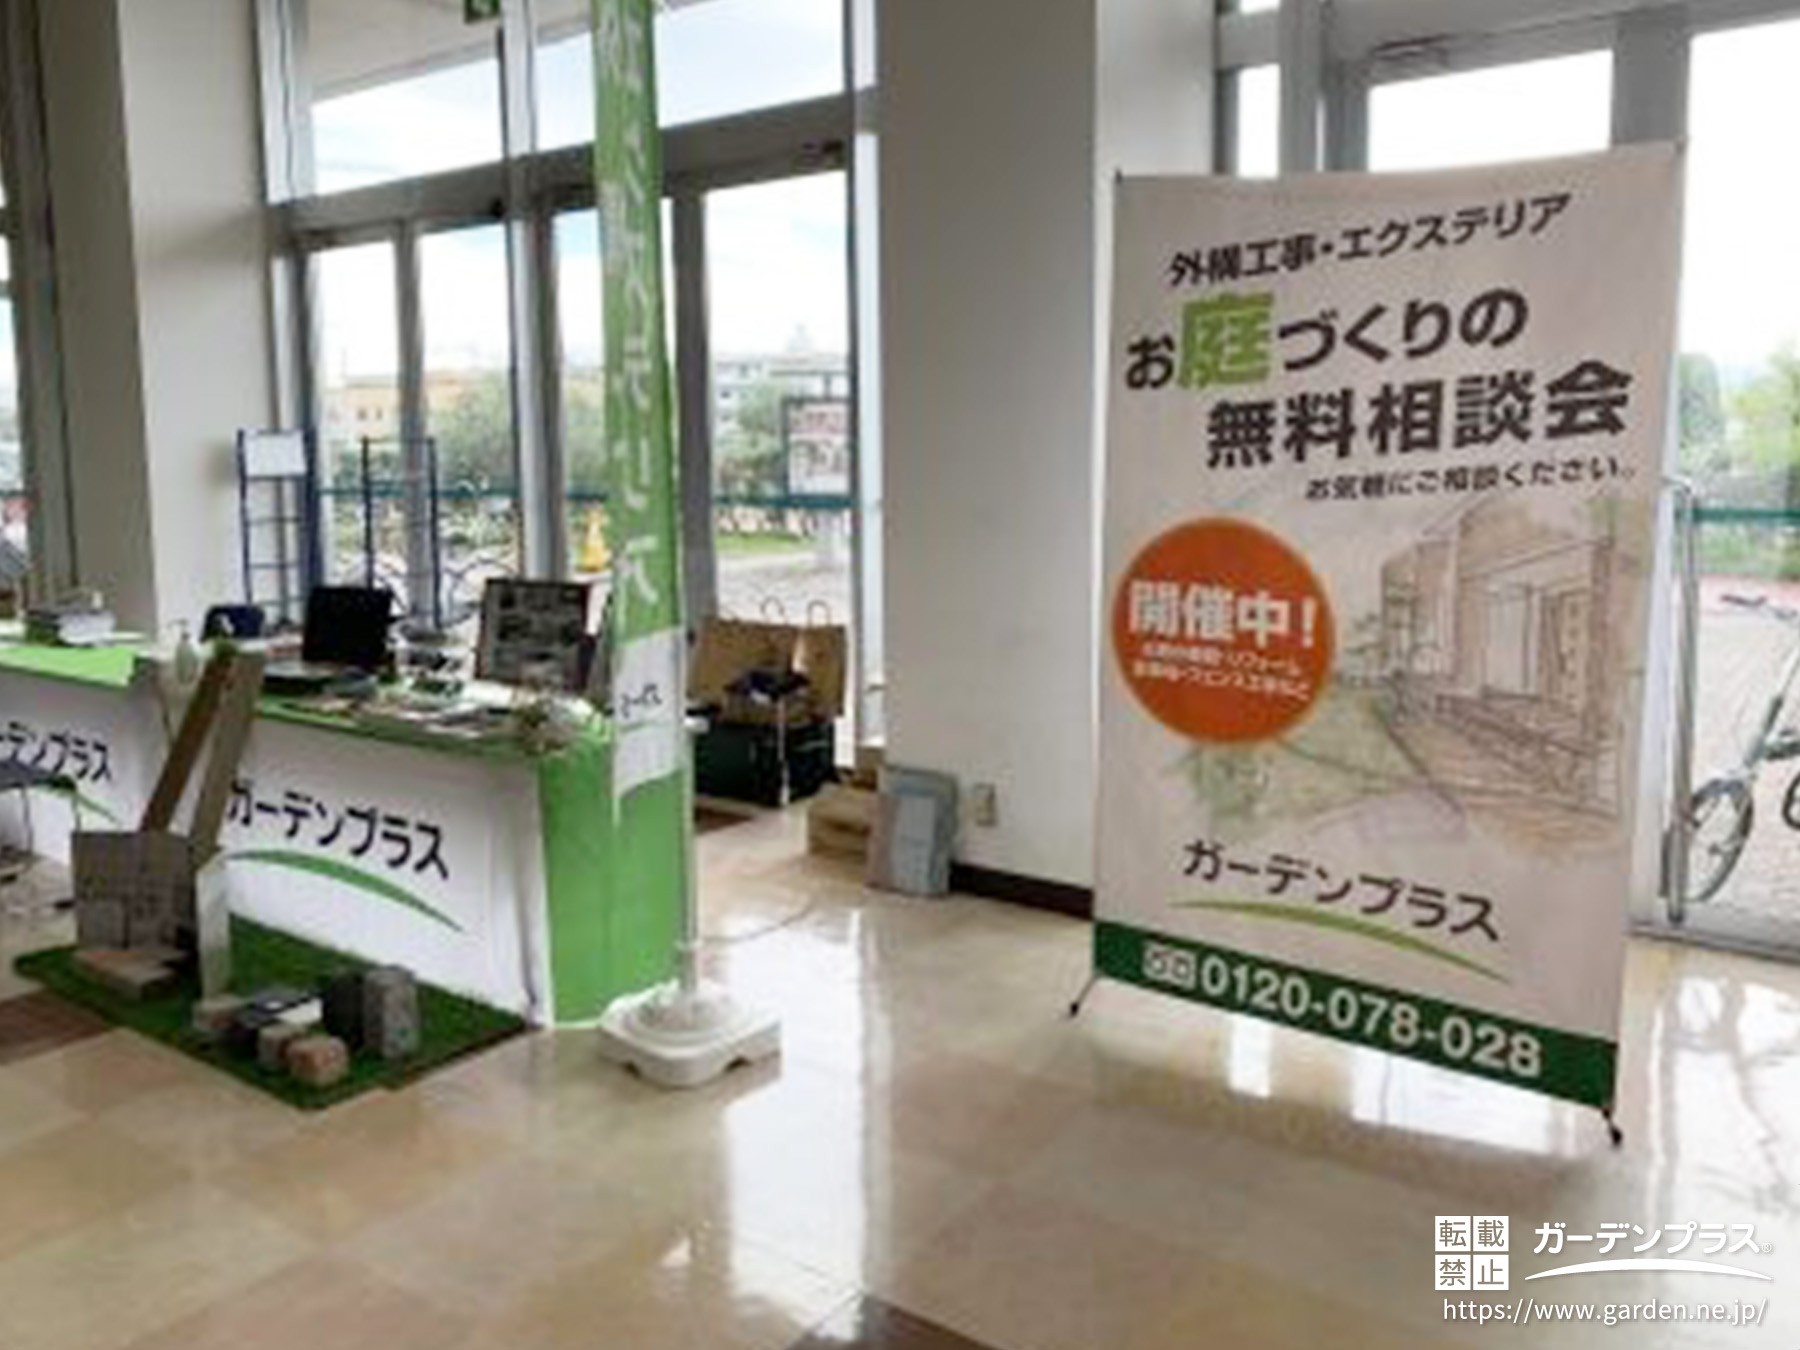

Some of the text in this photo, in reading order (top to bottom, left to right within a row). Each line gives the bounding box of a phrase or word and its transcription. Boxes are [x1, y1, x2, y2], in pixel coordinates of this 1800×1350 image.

[1169, 193, 1572, 286] 外構工事・エクステリア
[1125, 287, 1528, 391] お庭づくりの
[1206, 360, 1632, 469] 無料相談会
[1128, 578, 1316, 649] 開催中！
[227, 780, 450, 881] ガーデンプラス
[1183, 840, 1500, 942] ガーデンプラス
[1200, 956, 1542, 1077] 0120-078-028
